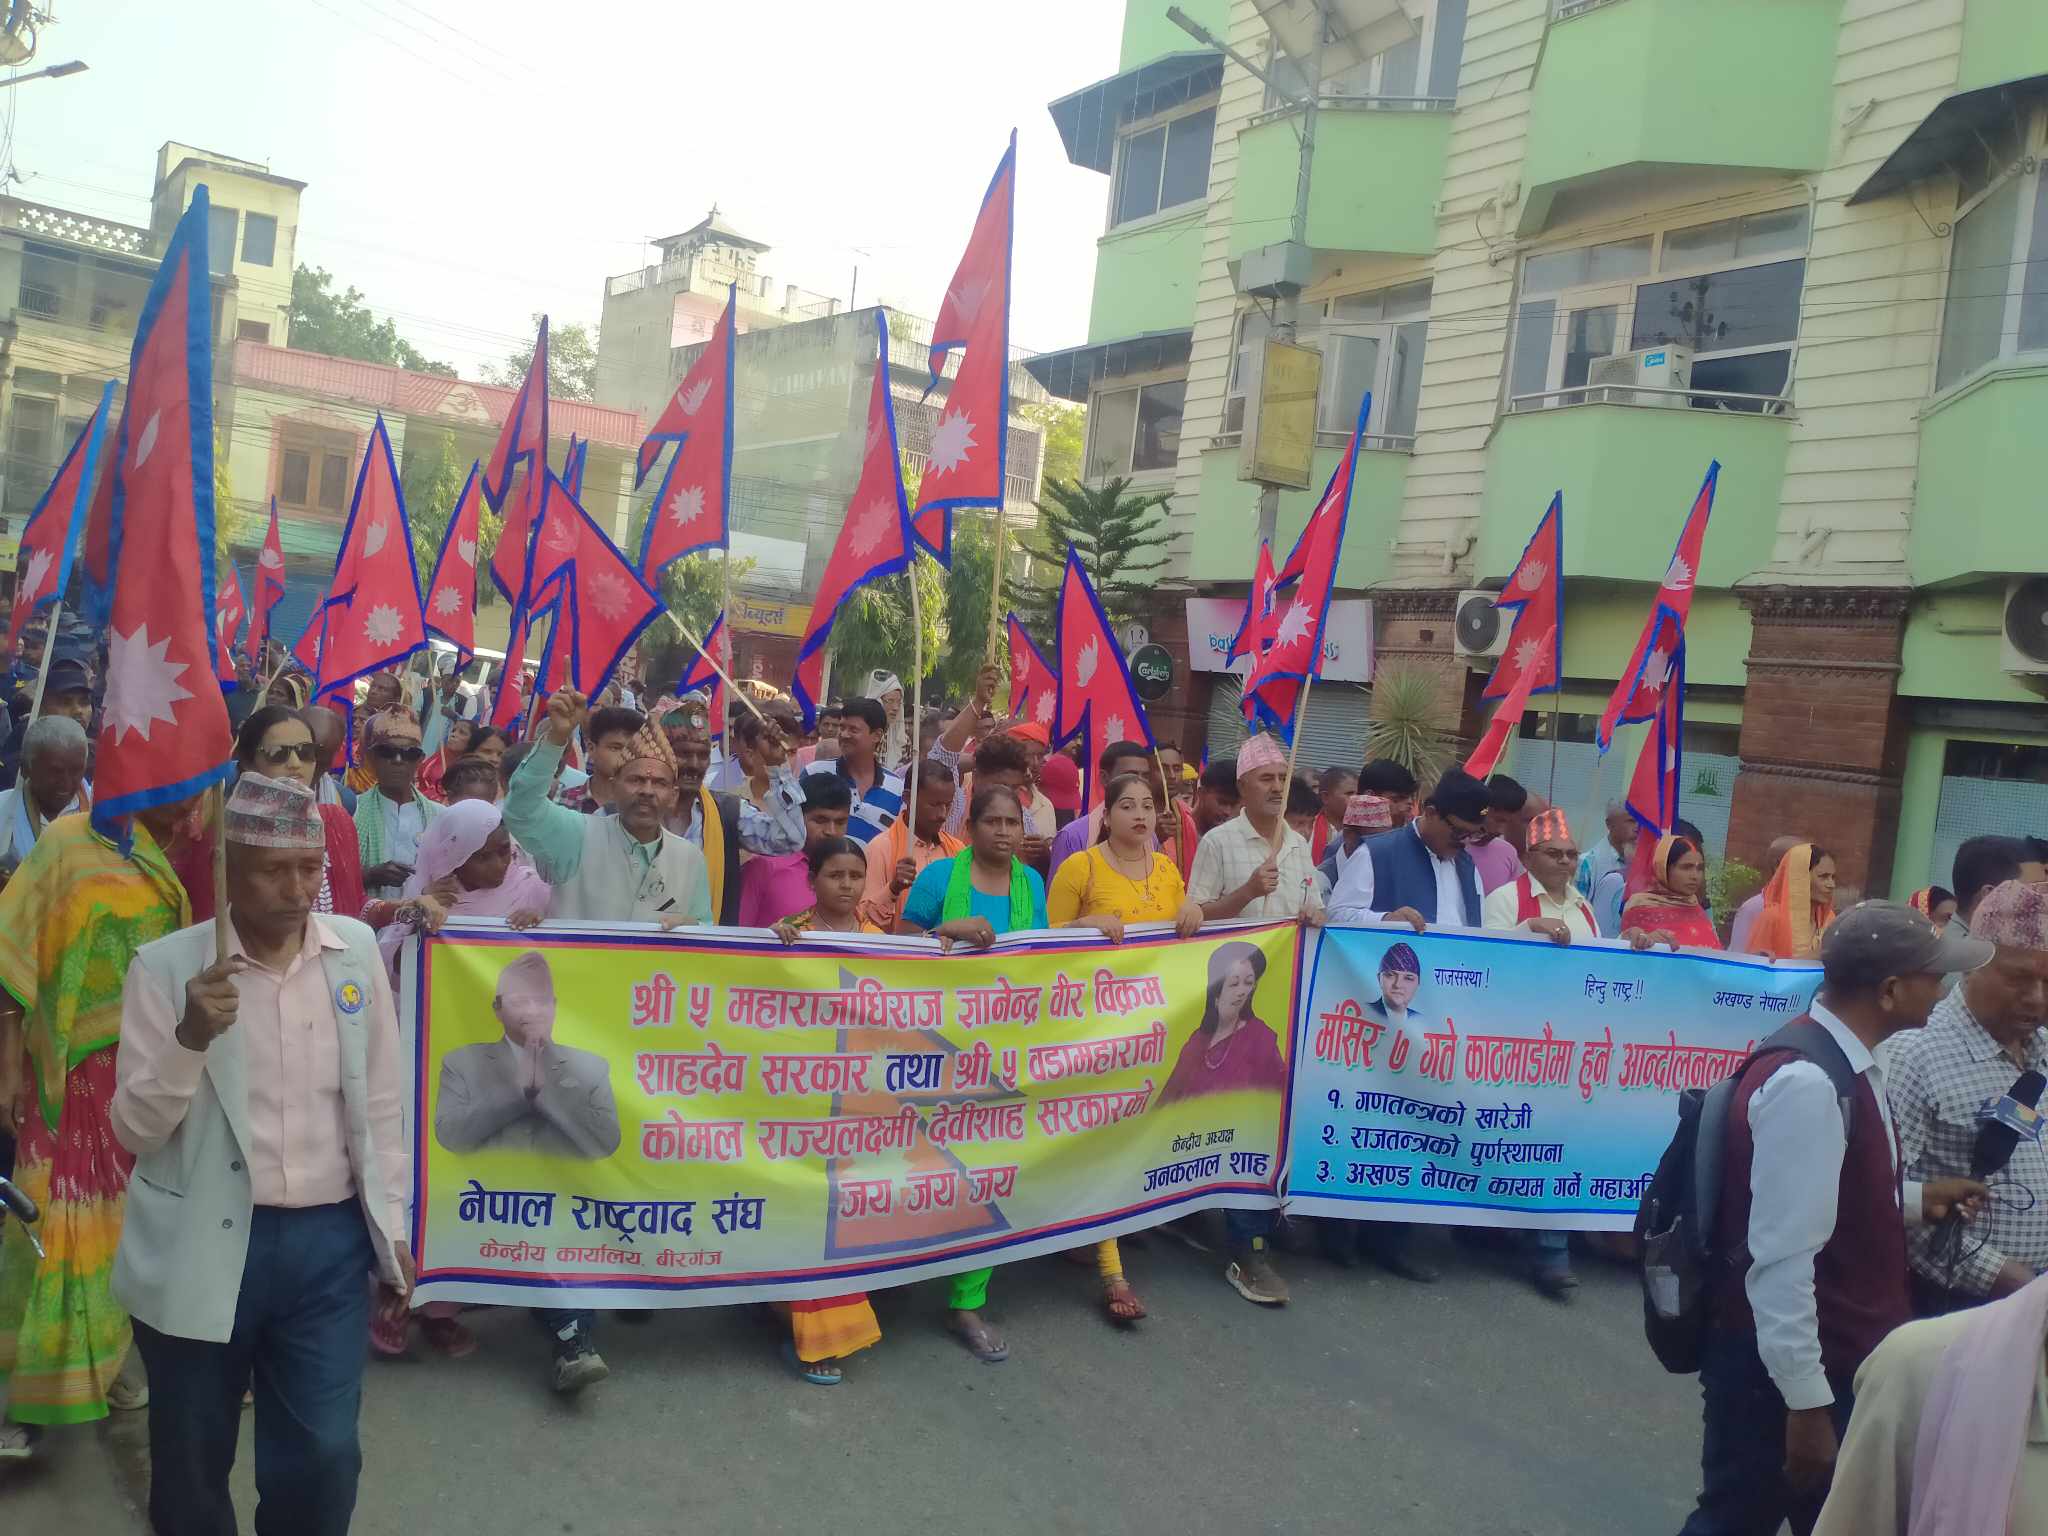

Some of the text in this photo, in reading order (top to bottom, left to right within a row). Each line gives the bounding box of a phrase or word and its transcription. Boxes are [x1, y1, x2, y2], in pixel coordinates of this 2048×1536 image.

[633, 969, 1166, 1029] श्री ५ महाराजाधिराज ज्ञानेन्द्र वीर विक्रम
[1584, 973, 1608, 1005] हिन्दु
[1712, 991, 1754, 1008] अखण्ड
[638, 1042, 748, 1095] शाहदेव
[762, 1055, 872, 1095] सरकार
[886, 1054, 944, 1091] तथा
[955, 1041, 991, 1089] श्री
[1001, 1050, 1017, 1088] ५
[1315, 998, 1386, 1067] मंसिर
[1388, 1029, 1410, 1070] ७
[1419, 1018, 1458, 1082] गते
[1579, 1026, 1614, 1100] हुने
[643, 1080, 1156, 1161] कोमल राज्यलक्ष्मी देवीशाह सरकारको
[1355, 1091, 1466, 1127] गणतन्त्रको
[1475, 1102, 1532, 1129] खारेजी
[1172, 1128, 1236, 1153] केन्द्रीय अध्यक्ष
[1351, 1126, 1461, 1158] राजतन्त्रको
[1471, 1138, 1564, 1167] पुर्णस्थापना
[841, 1166, 1018, 1217] जय जय जय
[1144, 1152, 1270, 1192] जनकलाल शाह
[1346, 1162, 1412, 1187] अखण्ड
[1421, 1161, 1481, 1193] नेपाल
[1488, 1176, 1545, 1198] कायम
[1553, 1172, 1583, 1197] गर्ने
[458, 1180, 766, 1243] नेपाल राष्ट्रवाद संघ
[479, 1238, 546, 1263] केन्द्रीय
[656, 1248, 722, 1267] बीरगंज
